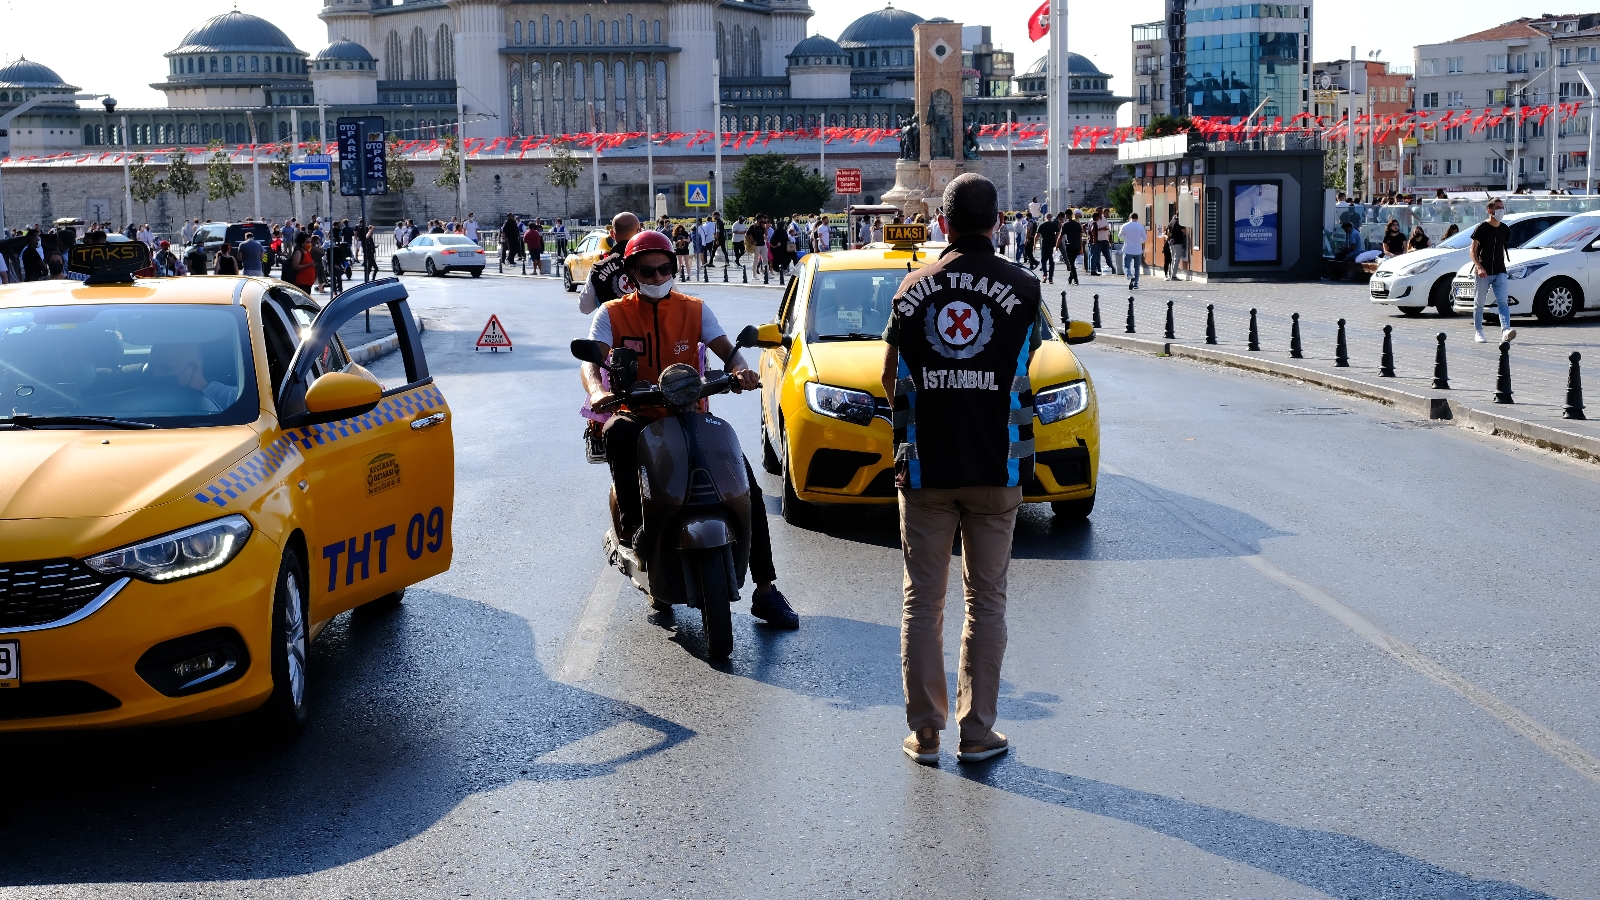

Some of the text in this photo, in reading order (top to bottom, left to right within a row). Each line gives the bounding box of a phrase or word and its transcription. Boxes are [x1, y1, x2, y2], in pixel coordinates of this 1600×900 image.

[306, 154, 332, 163] OTOPARK
[347, 130, 356, 159] PARK
[374, 150, 384, 178] PARK
[899, 272, 1022, 316] SİVİL TRAFİK
[922, 367, 998, 390] İSTANBUL
[323, 506, 444, 592] THT 09
